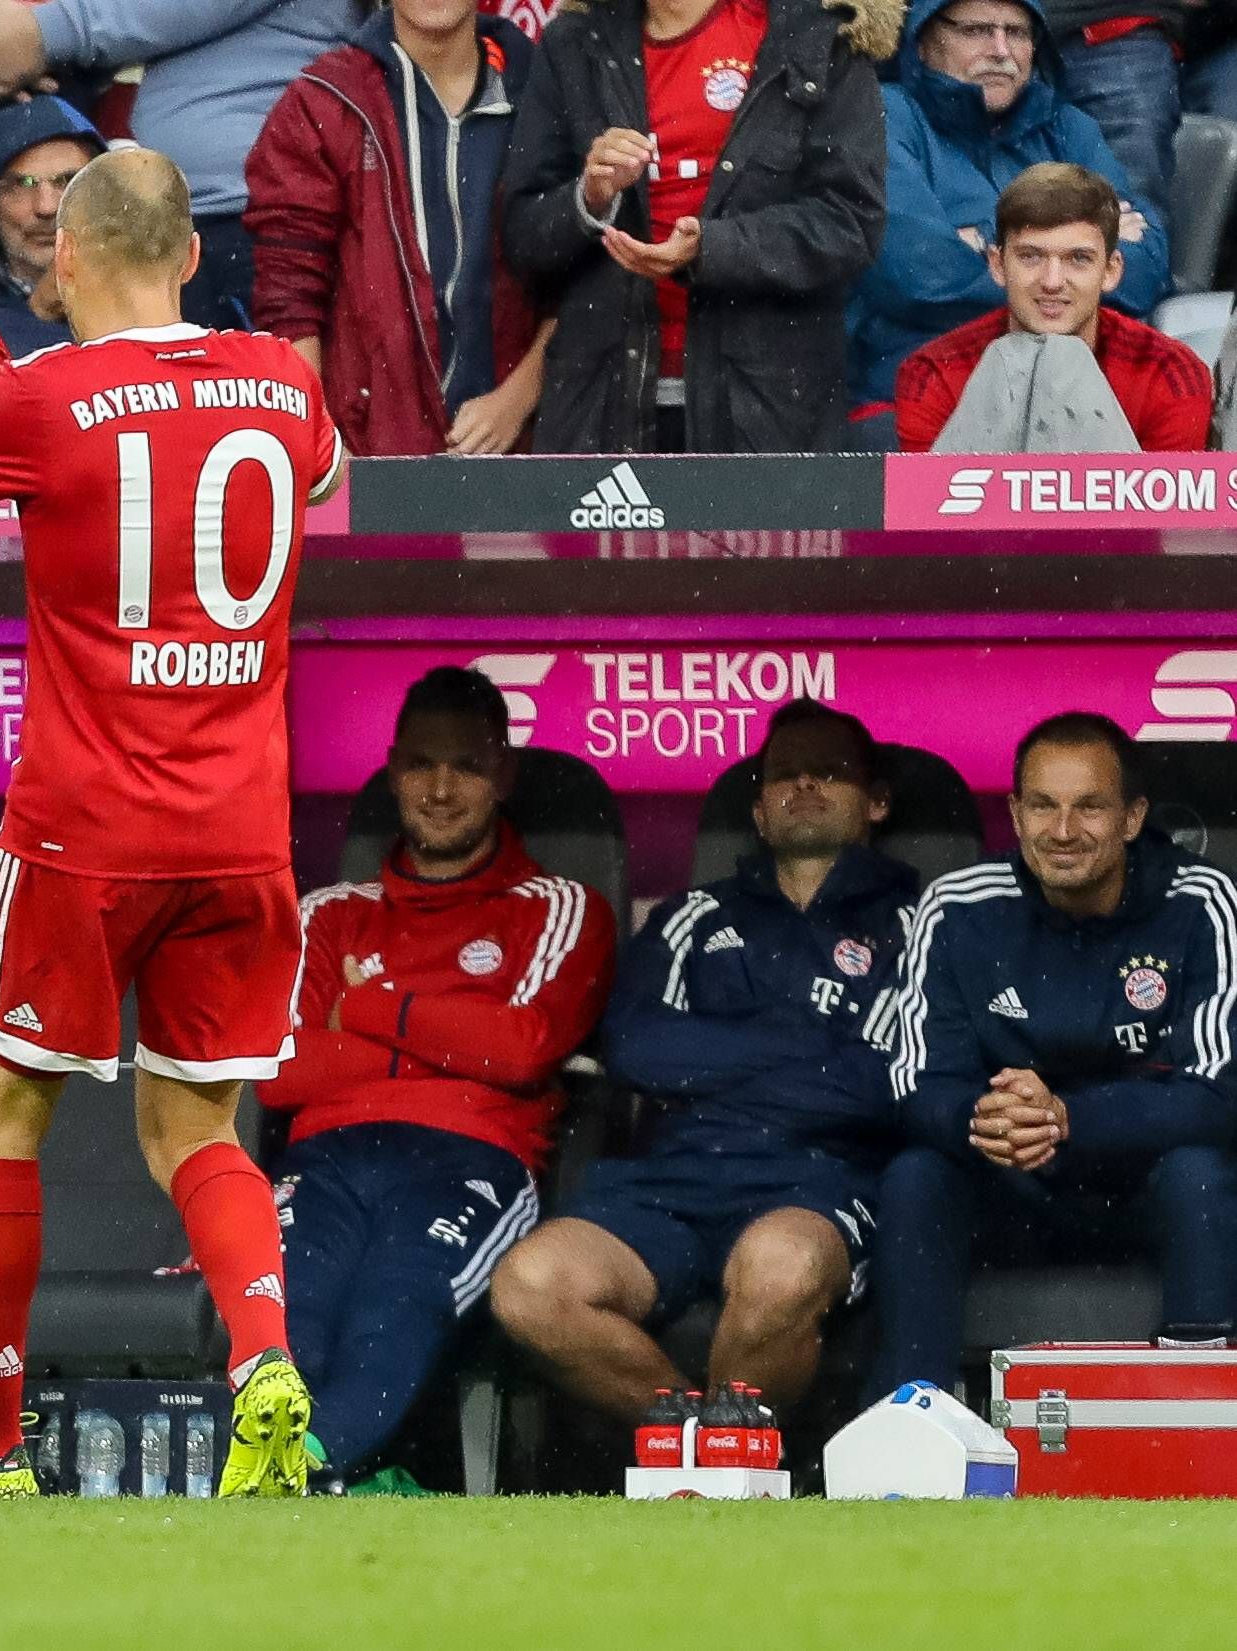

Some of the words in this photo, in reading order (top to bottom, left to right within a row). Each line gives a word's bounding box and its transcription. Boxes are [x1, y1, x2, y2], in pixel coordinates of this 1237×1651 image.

[70, 381, 181, 432] BAYERN
[192, 378, 309, 422] MÜNCHEN
[1002, 468, 1216, 513] TELEKOM
[117, 428, 295, 631] 10
[570, 502, 666, 530] adidas
[131, 640, 266, 687] ROBBEN
[583, 652, 837, 701] TELEKOM
[585, 705, 758, 759] SPORT
